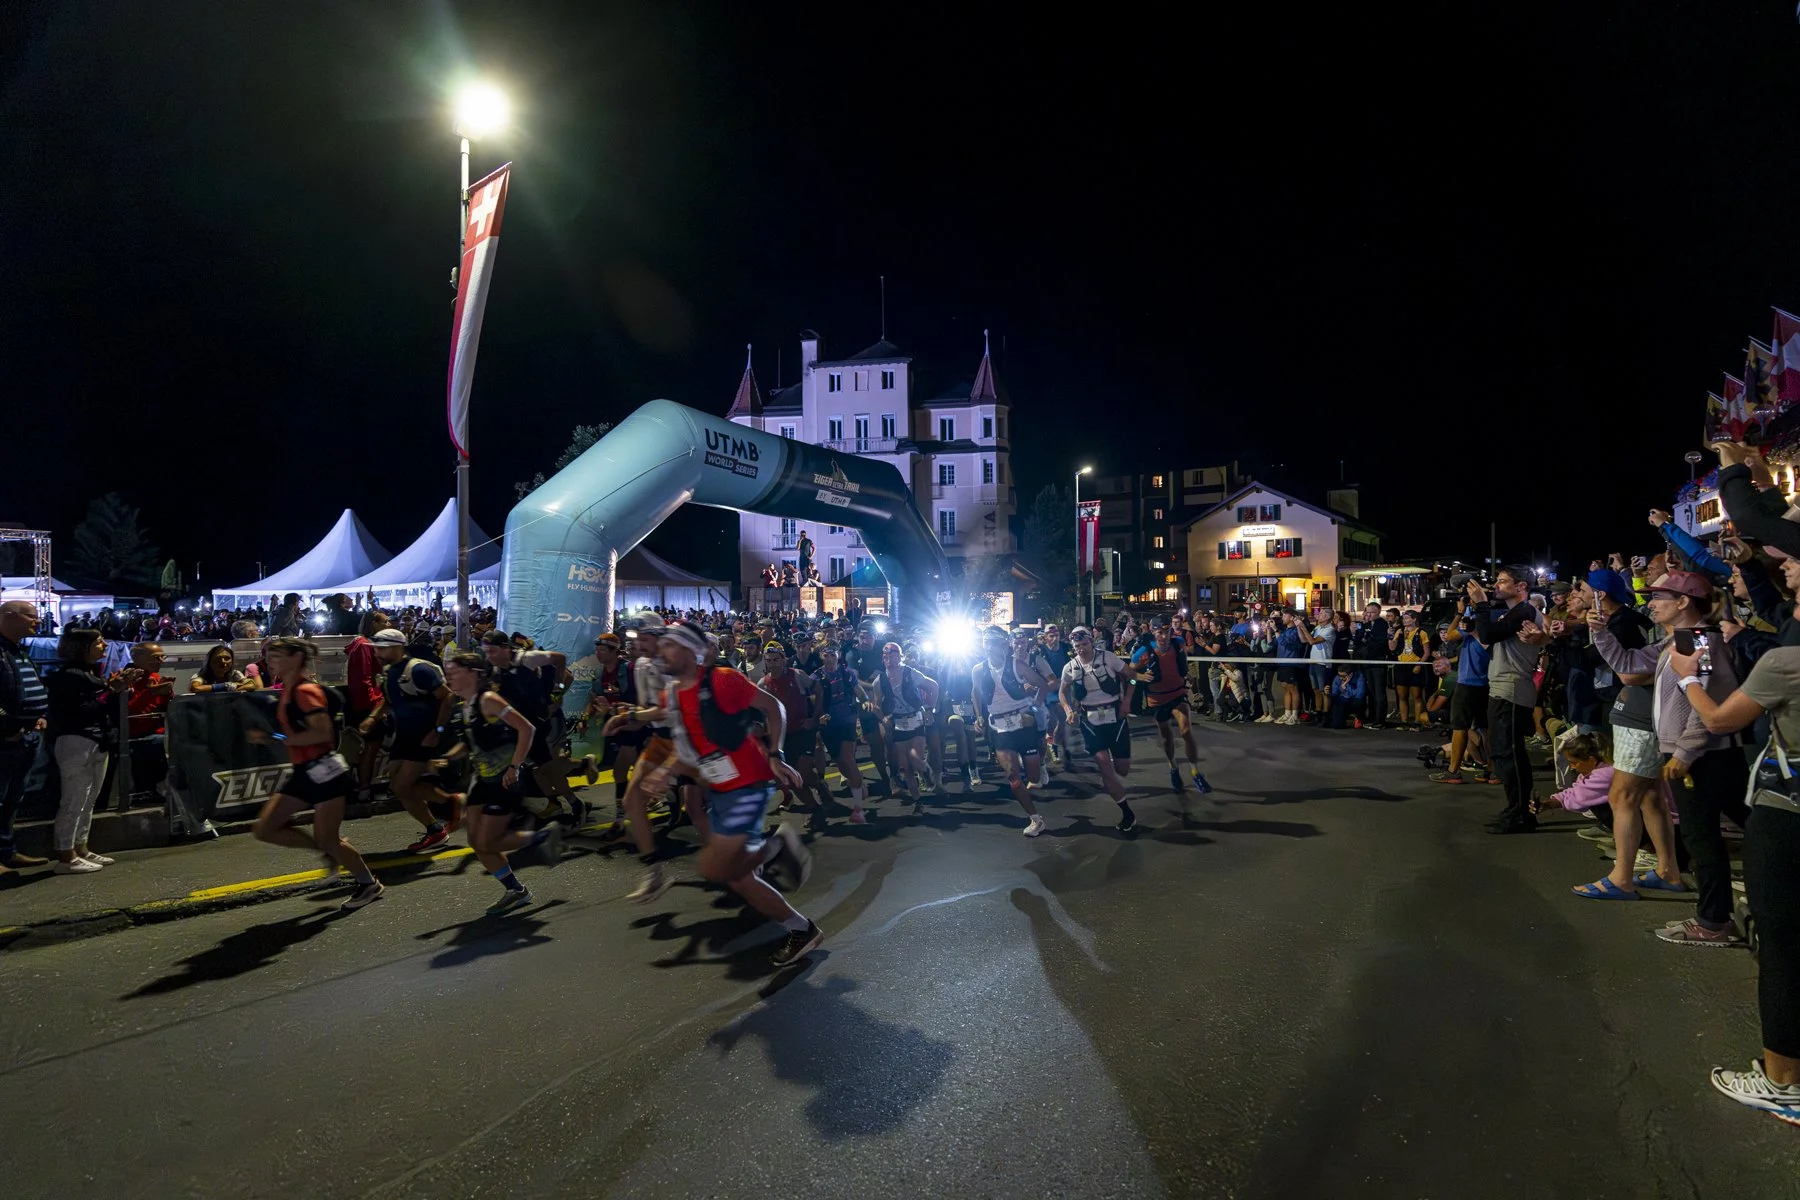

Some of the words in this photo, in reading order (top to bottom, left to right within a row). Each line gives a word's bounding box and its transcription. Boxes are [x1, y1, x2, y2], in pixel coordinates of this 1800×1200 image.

[705, 428, 759, 462] UTMB
[708, 454, 734, 469] WORLD
[735, 464, 757, 477] SERIES
[813, 474, 833, 487] EIGER
[843, 481, 860, 493] TRAIL
[556, 612, 604, 625] DACI
